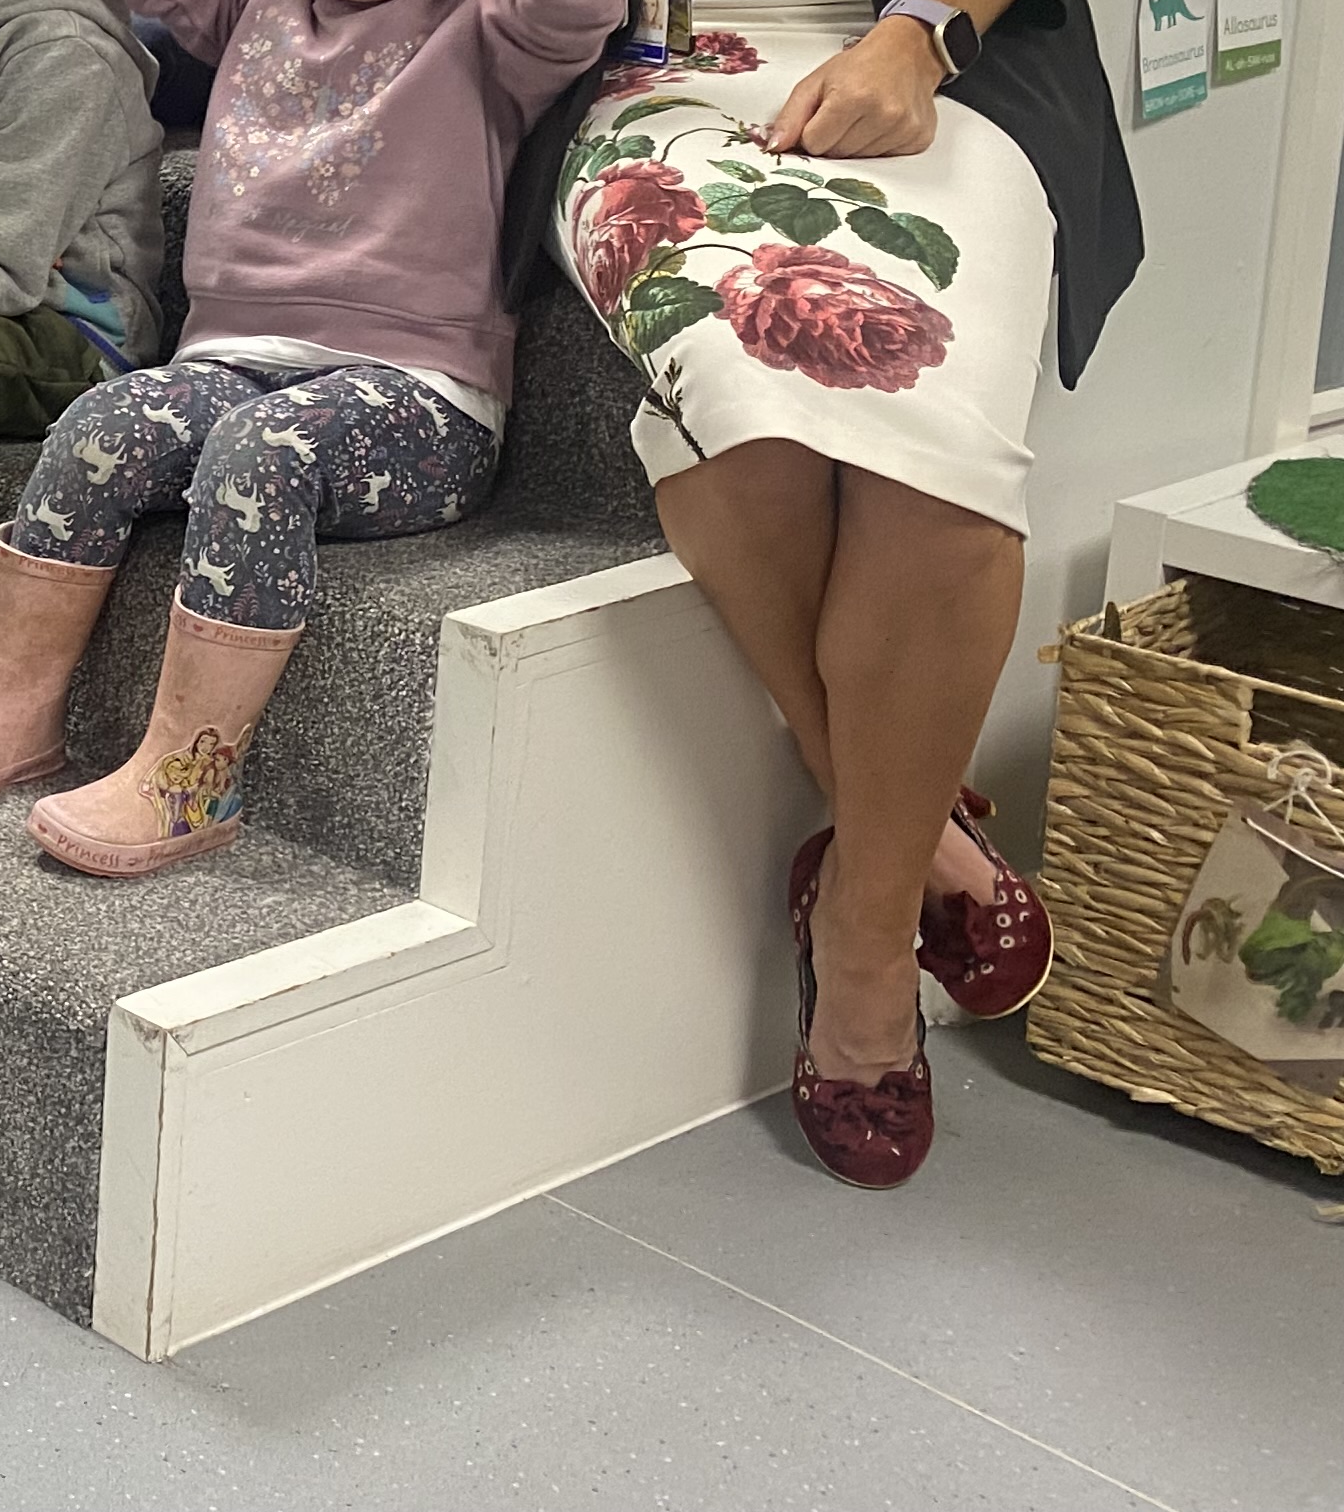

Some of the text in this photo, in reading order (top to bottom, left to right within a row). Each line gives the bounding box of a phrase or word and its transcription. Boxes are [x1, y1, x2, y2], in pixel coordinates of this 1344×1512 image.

[1224, 14, 1278, 36] Allosaurus
[214, 626, 267, 646] Princess
[57, 834, 120, 868] Princess
